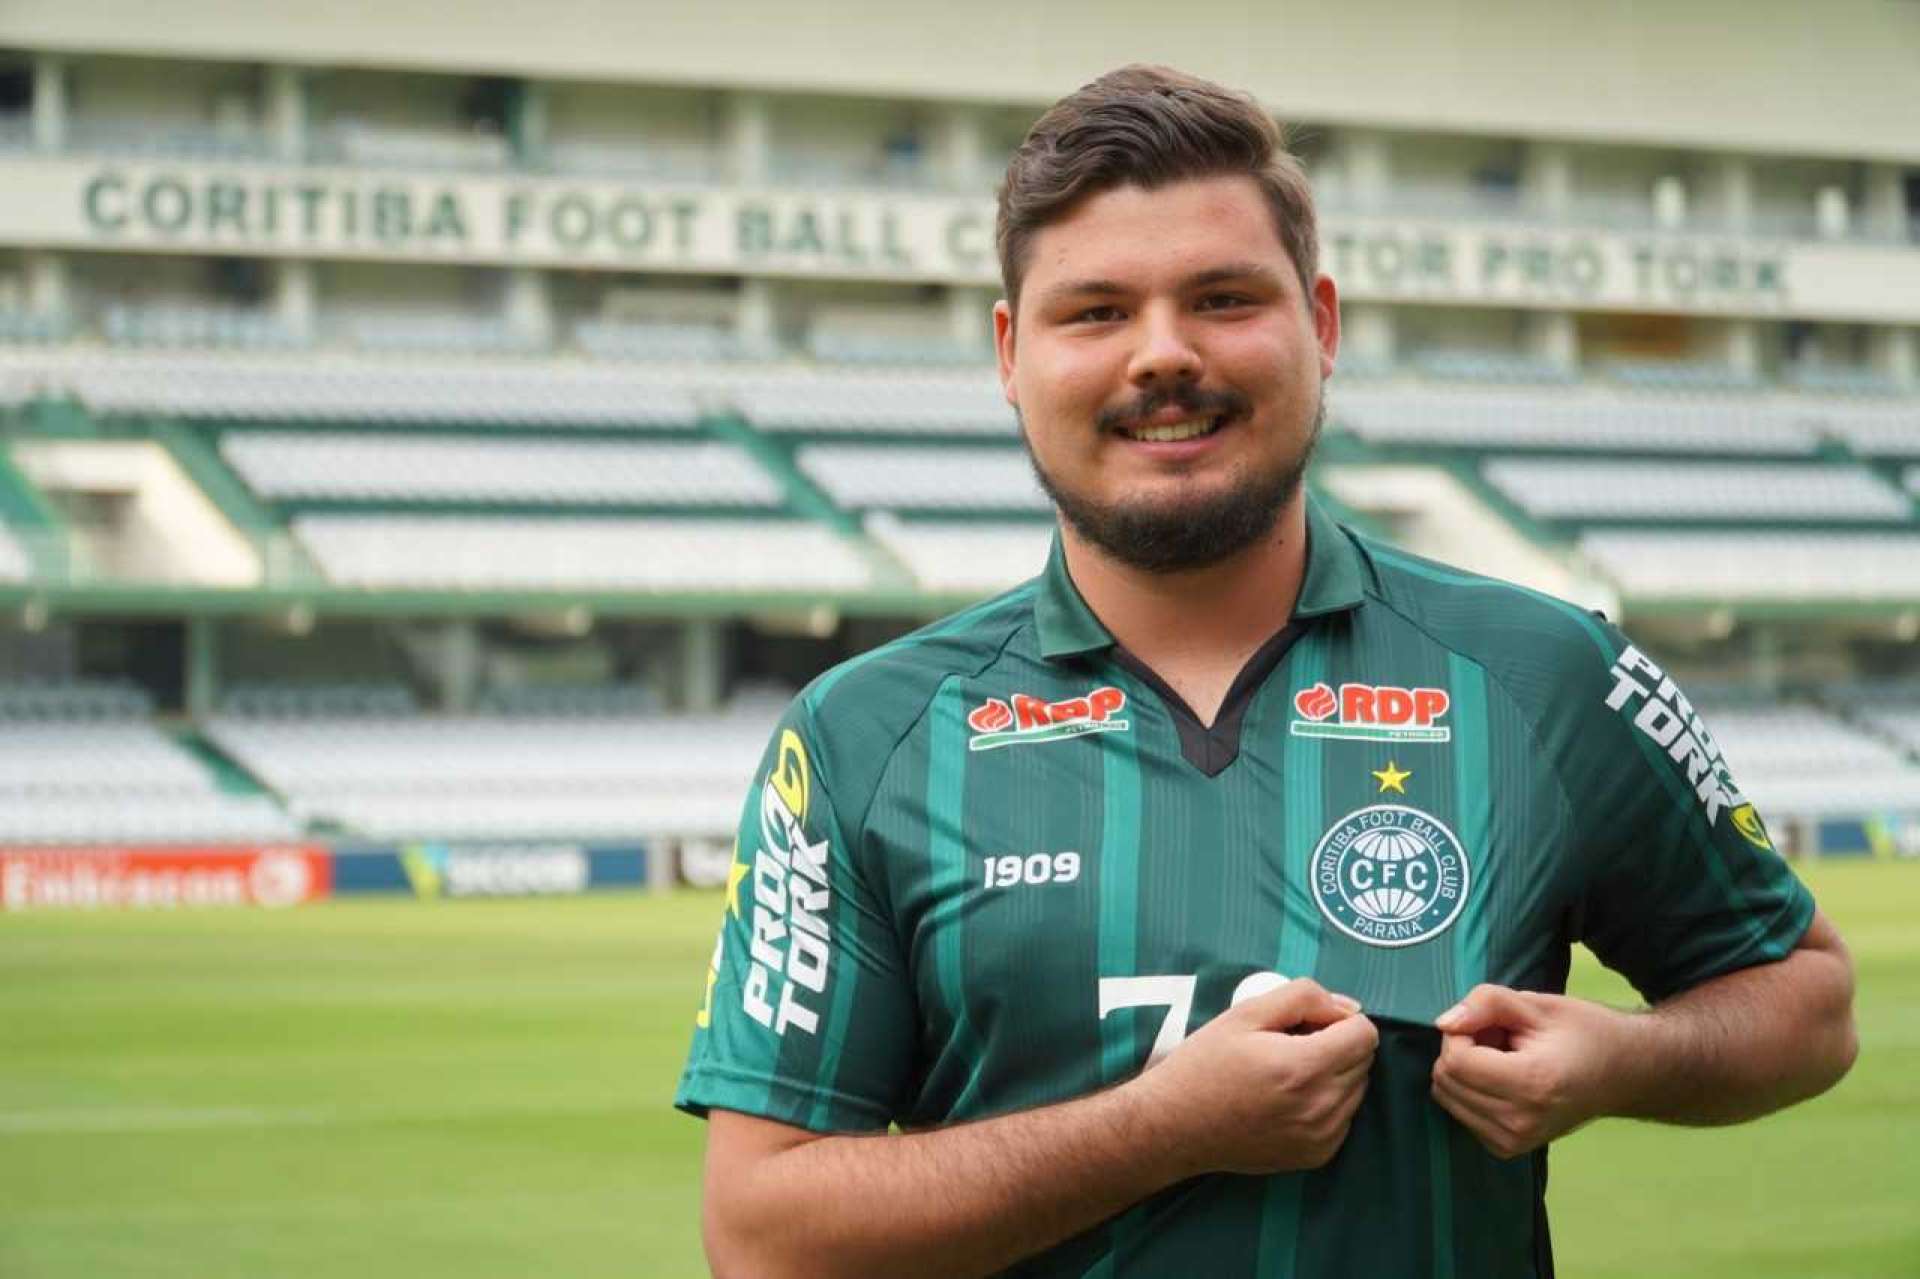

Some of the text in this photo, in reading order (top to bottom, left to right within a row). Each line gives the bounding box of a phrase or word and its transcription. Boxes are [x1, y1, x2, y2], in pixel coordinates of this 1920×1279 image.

[82, 172, 470, 242] CORITIBA
[504, 192, 702, 252] FOOT
[734, 204, 914, 264] BALL
[1482, 240, 1604, 292] PRO
[1632, 246, 1786, 296] TORK
[1011, 687, 1126, 731] RDP
[1339, 683, 1451, 728] RDP
[1605, 664, 1733, 828] TORK
[984, 852, 1081, 888] 1909
[1319, 810, 1458, 899] CORITIBA FOOT BALL CLUB
[743, 849, 787, 1028] PRO
[775, 838, 829, 1036] TORK
